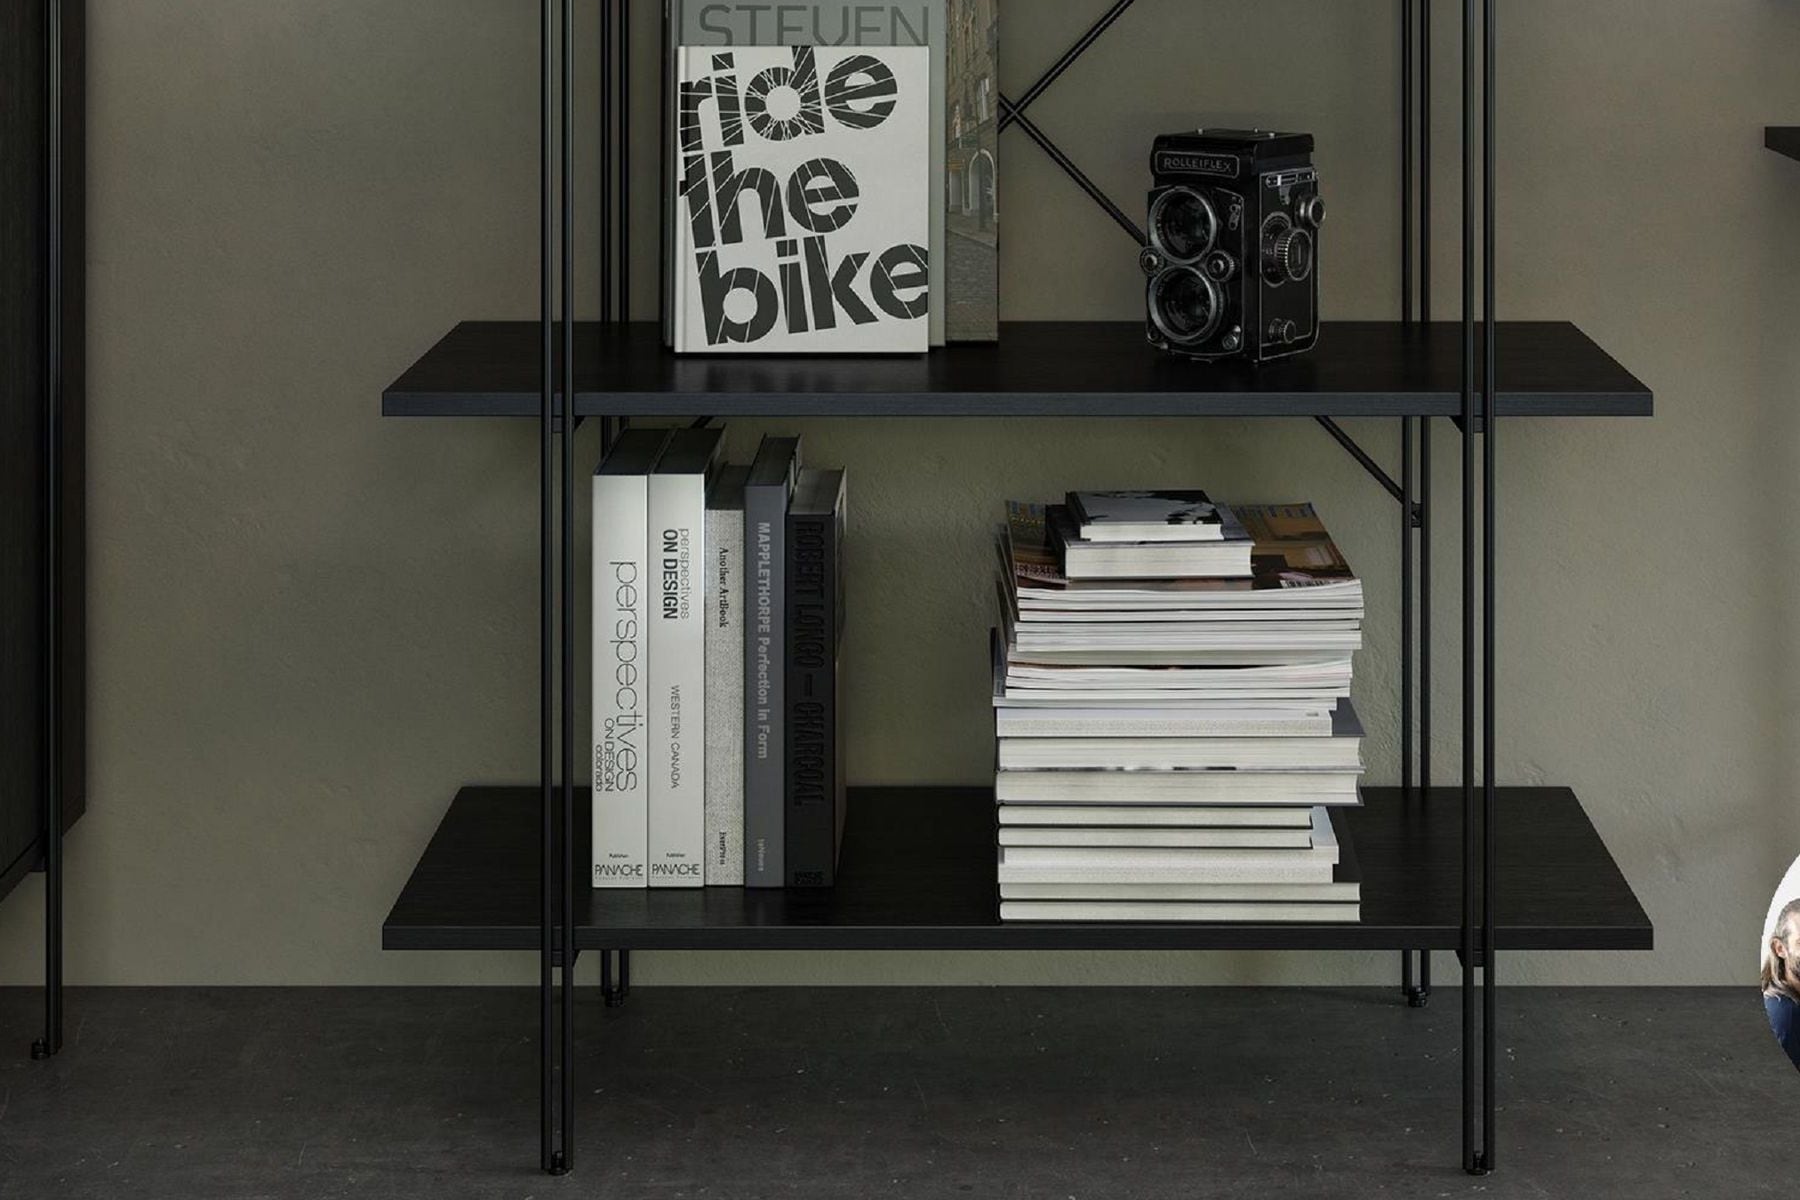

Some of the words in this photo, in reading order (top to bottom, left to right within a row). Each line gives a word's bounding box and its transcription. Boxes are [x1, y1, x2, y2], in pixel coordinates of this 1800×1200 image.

[680, 46, 898, 152] ride
[1163, 157, 1231, 172] ROLLEIFLEX
[695, 235, 929, 346] bike
[663, 529, 678, 552] ON
[795, 521, 825, 598] ROBERT
[663, 558, 678, 619] DESIGN
[679, 528, 690, 620] perspectives
[719, 547, 730, 586] Another
[758, 522, 770, 632] MAPPLETHORPE
[719, 587, 730, 628] ArtBook
[609, 561, 644, 793] perspectives
[758, 637, 771, 705] Perfection
[604, 718, 615, 739] ON
[671, 685, 680, 739] WESTERN
[604, 741, 615, 792] DESIGN
[671, 743, 680, 790] CANADA
[758, 725, 770, 759] Form
[595, 744, 604, 792] colorado
[594, 864, 643, 877] PANACHE
[651, 863, 700, 877] PANACHE
